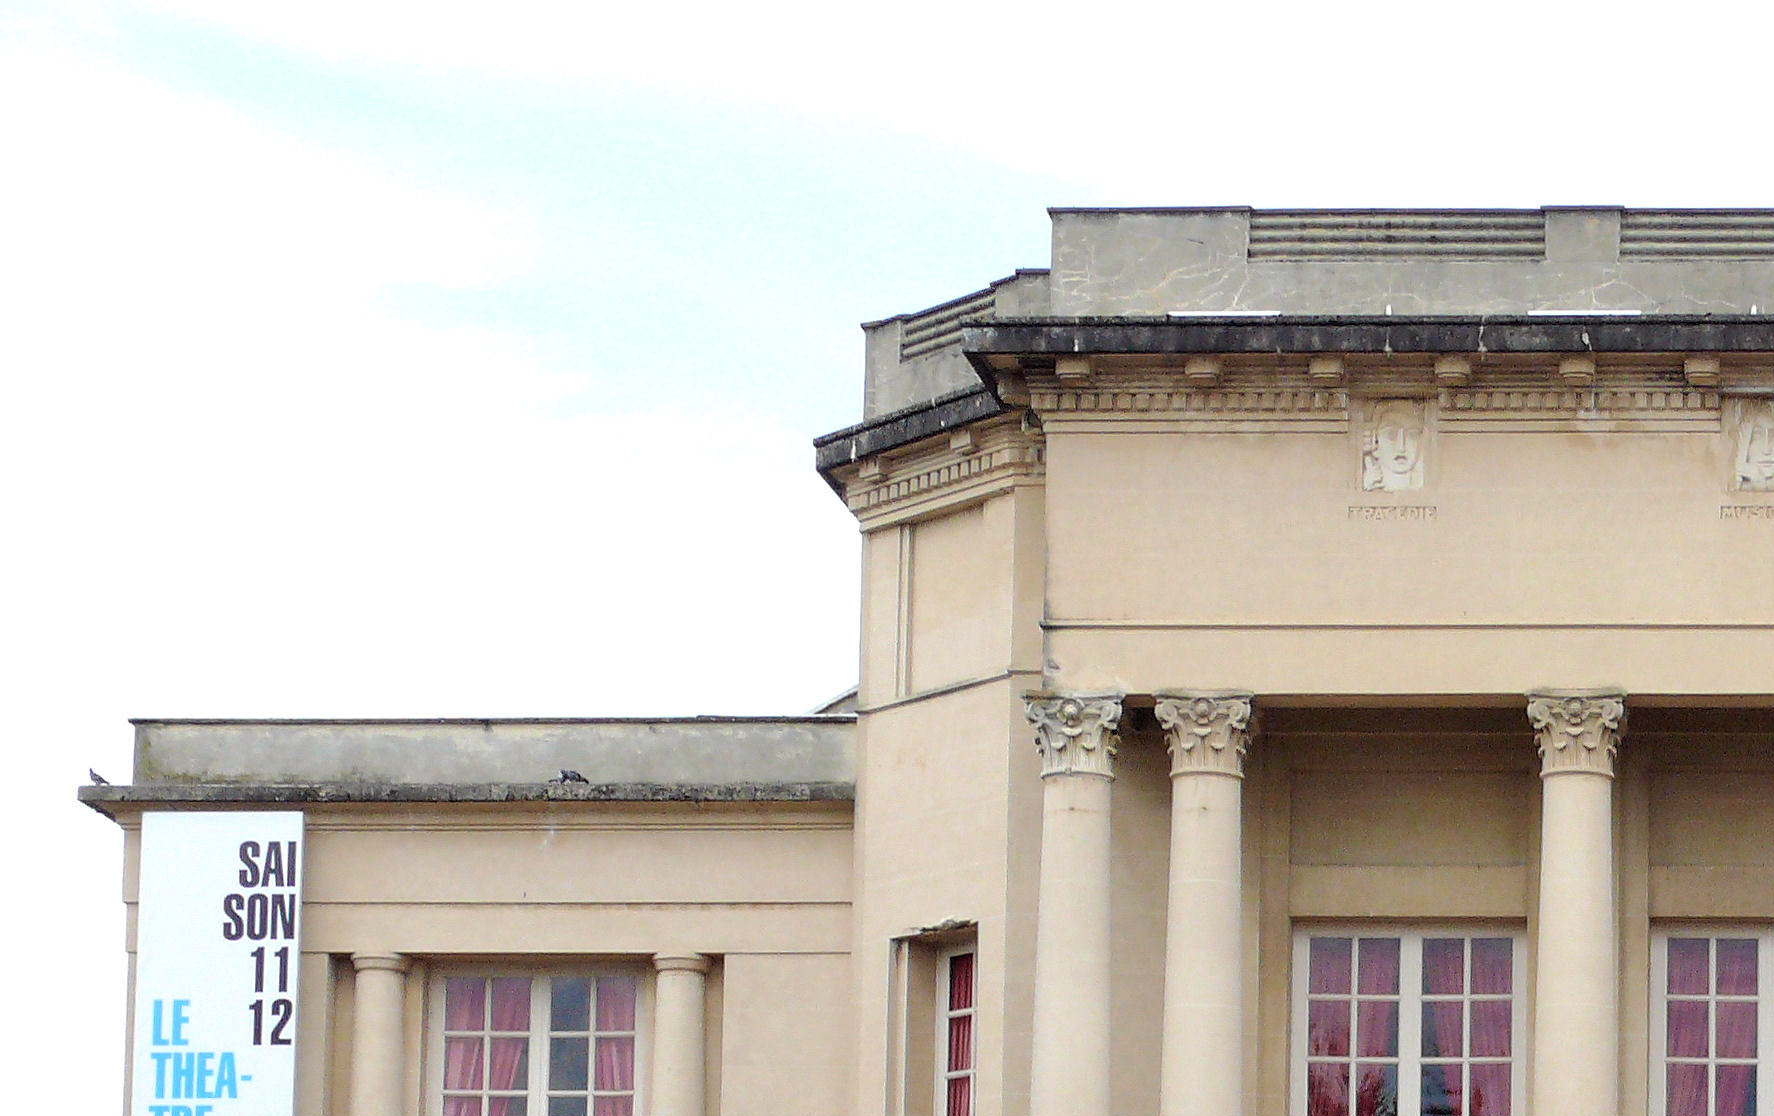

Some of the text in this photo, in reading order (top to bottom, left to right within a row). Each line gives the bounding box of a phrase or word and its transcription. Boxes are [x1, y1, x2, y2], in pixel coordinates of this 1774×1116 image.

[239, 841, 297, 888] SAI
[223, 893, 296, 941] SON
[250, 946, 289, 993] 11
[152, 999, 190, 1046] LE
[249, 998, 293, 1046] 12
[150, 1052, 252, 1099] THEA-
